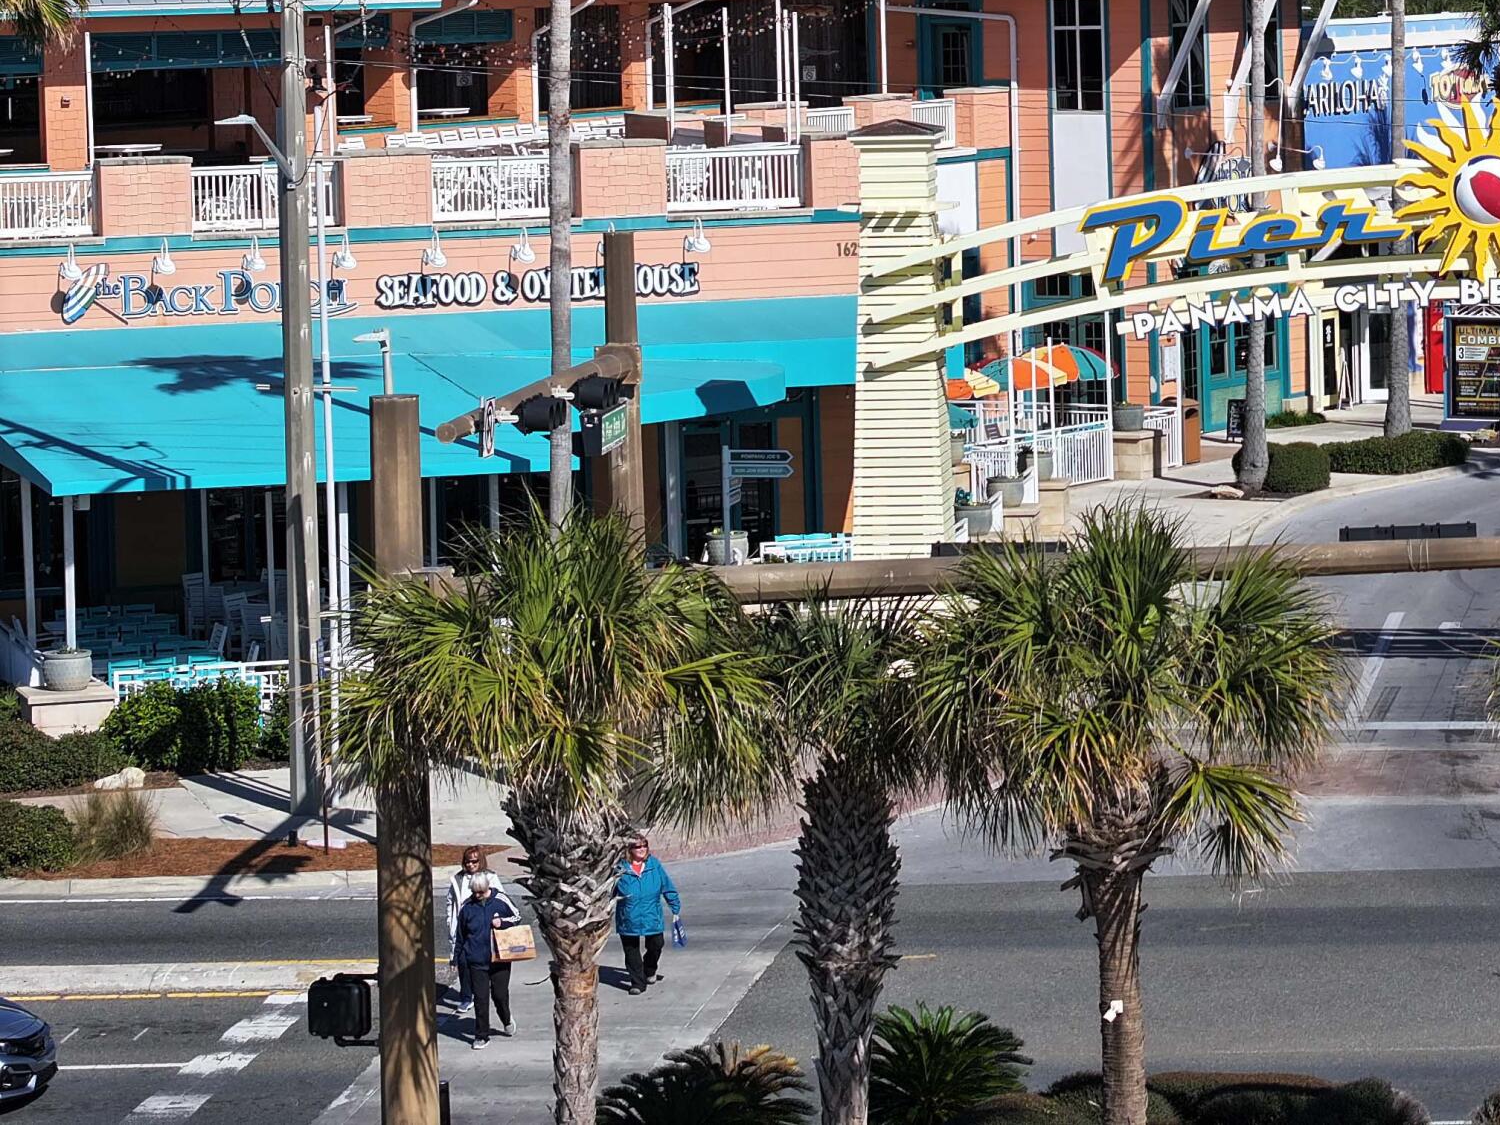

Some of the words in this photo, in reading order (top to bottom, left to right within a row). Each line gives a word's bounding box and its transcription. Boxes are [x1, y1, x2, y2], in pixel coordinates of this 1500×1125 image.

[1078, 194, 1412, 285] Pier
[95, 275, 120, 299] the
[375, 271, 488, 309] SEAFOOD
[492, 270, 518, 303] &
[1132, 286, 1316, 341] PANAMA
[1334, 279, 1436, 312] CITY
[1458, 327, 1500, 335] ULTIMAT
[1458, 347, 1464, 359] 3
